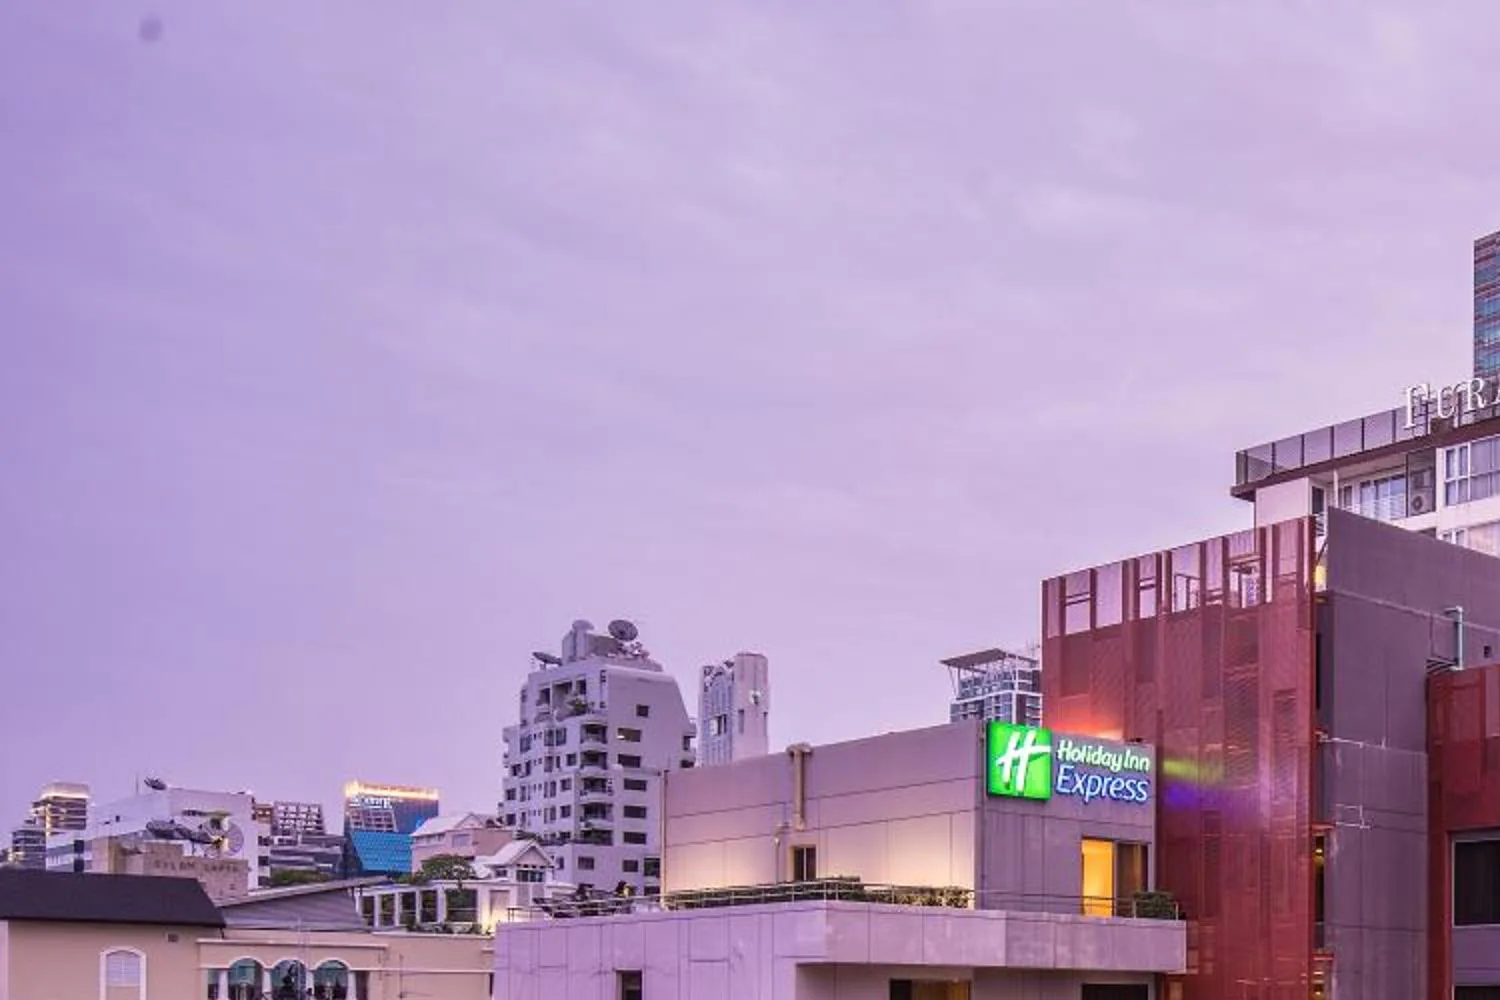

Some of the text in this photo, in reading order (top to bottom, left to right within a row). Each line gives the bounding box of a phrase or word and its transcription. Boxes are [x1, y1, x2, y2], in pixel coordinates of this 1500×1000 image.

[1057, 739, 1151, 773] Holiday Inn
[1056, 764, 1149, 803] Express
